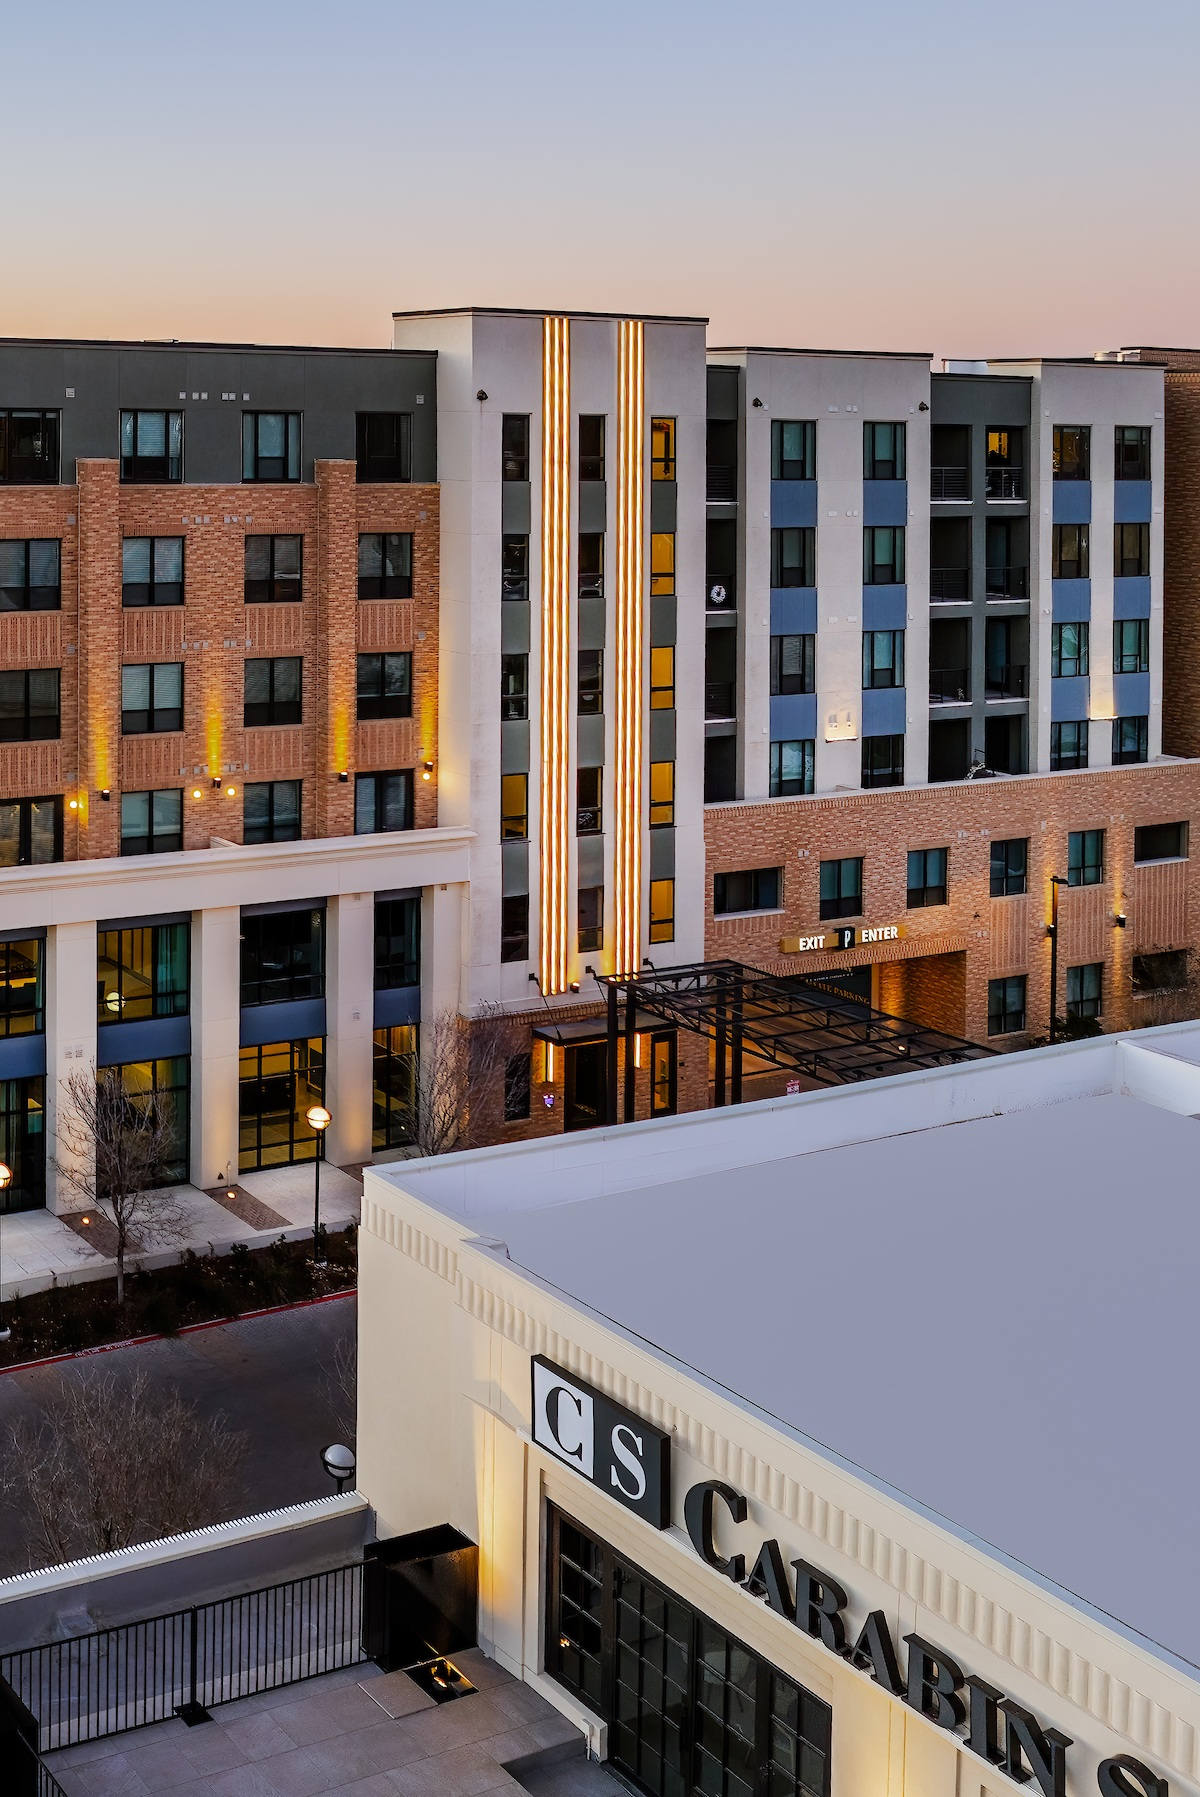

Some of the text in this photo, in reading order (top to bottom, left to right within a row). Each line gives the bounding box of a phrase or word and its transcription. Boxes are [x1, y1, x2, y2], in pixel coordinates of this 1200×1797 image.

[799, 935, 826, 952] EXIT
[861, 926, 899, 943] ENTER
[684, 1479, 1074, 1797] CARABIN
